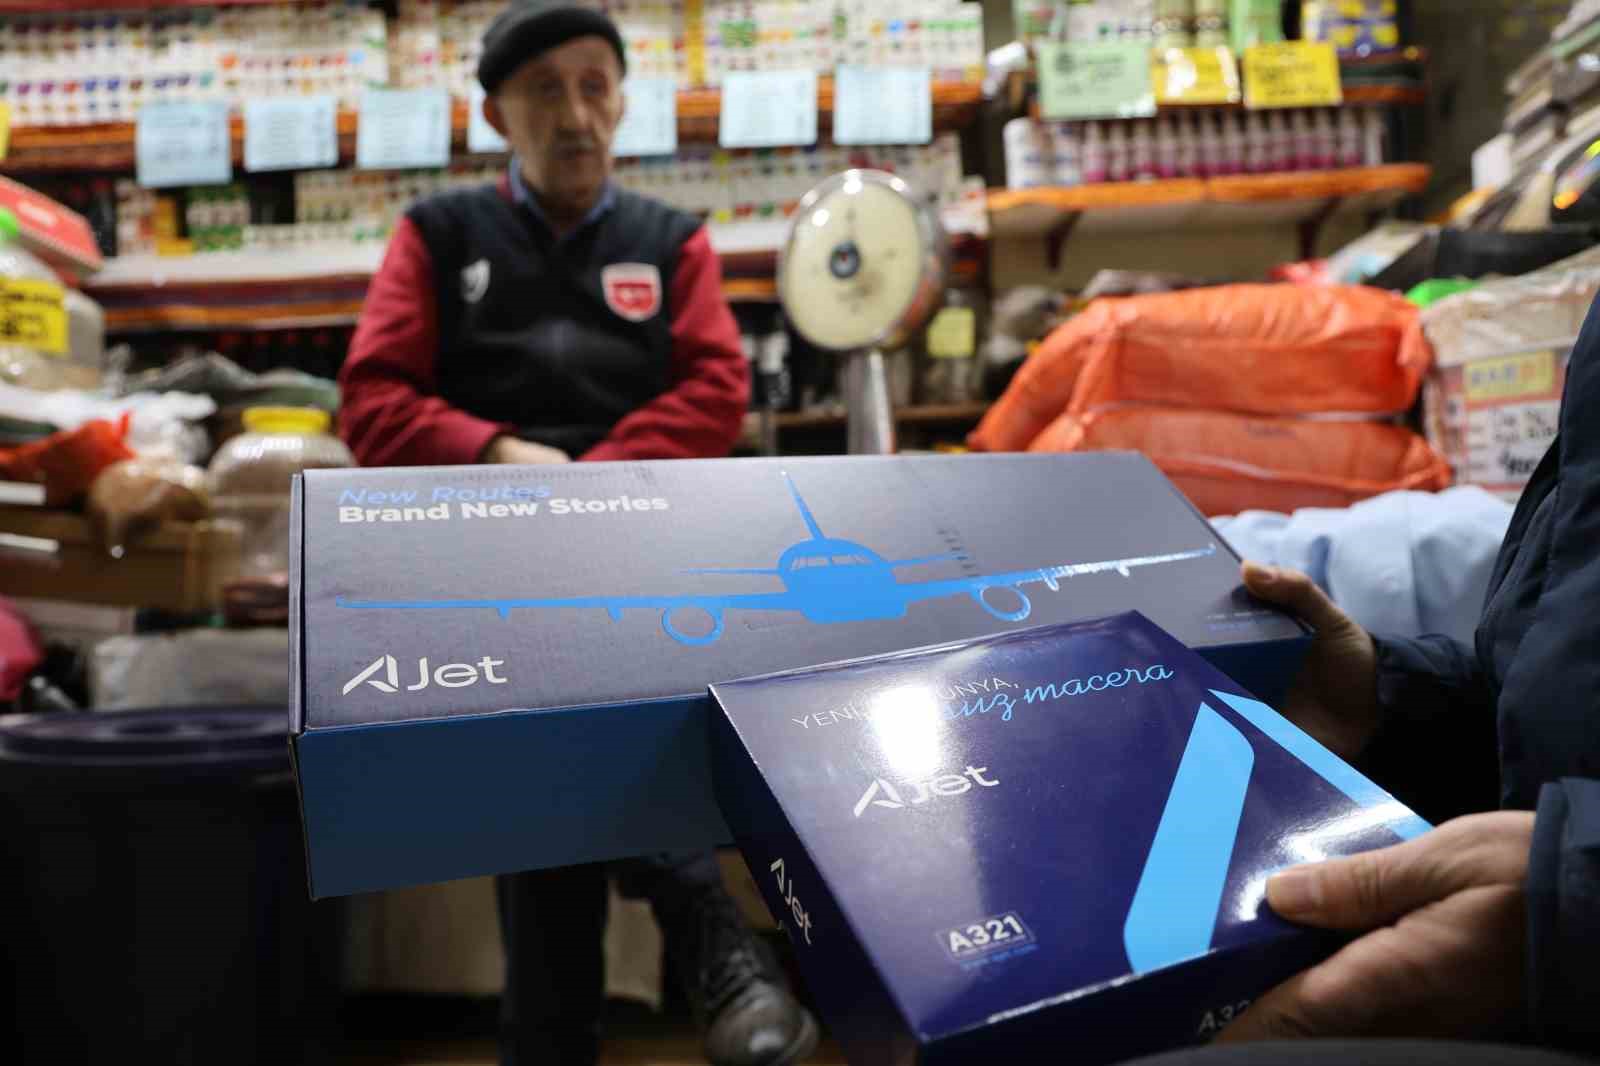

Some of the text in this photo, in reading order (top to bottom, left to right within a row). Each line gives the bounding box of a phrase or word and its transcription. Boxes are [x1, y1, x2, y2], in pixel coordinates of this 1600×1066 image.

[337, 481, 552, 505] New Routes
[338, 495, 670, 524] Brand New Stories
[1023, 664, 1174, 704] macera
[949, 914, 1024, 953] A321
